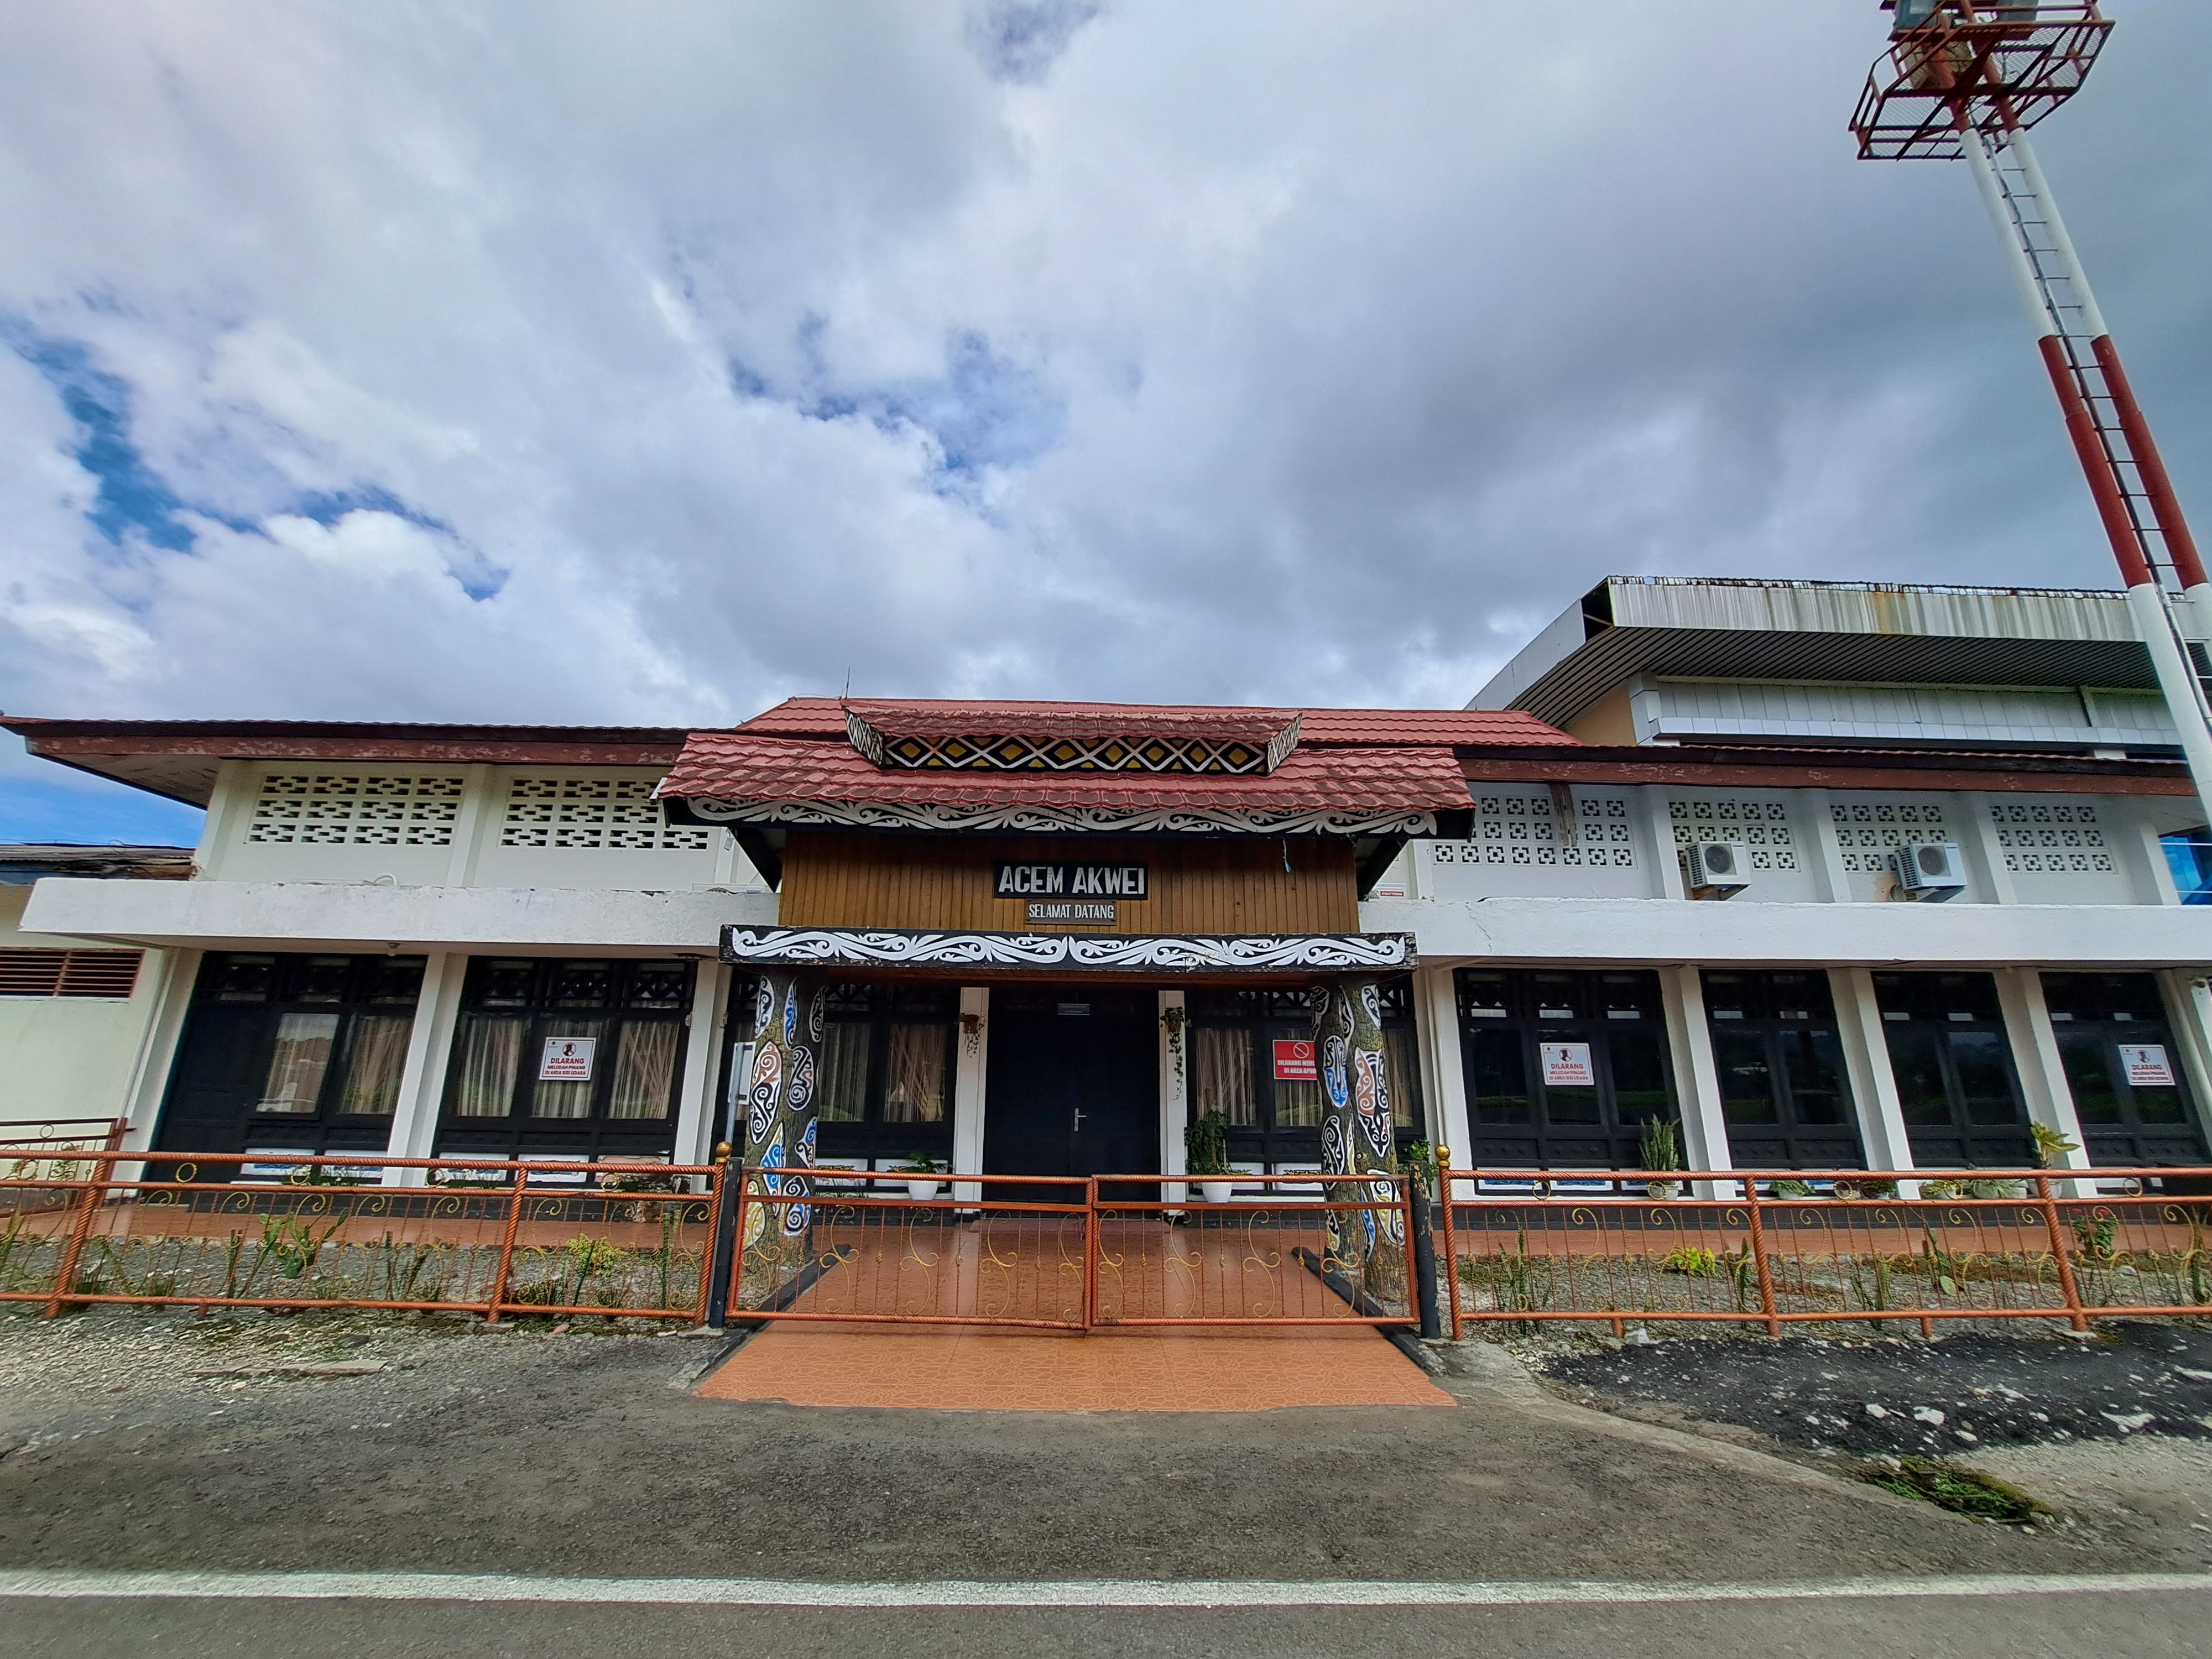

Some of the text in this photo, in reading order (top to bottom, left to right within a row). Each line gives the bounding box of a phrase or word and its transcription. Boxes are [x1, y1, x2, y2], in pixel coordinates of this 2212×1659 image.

[998, 865, 1145, 895] ACEM AKWEI
[1029, 904, 1114, 919] SELAMAT DATANG
